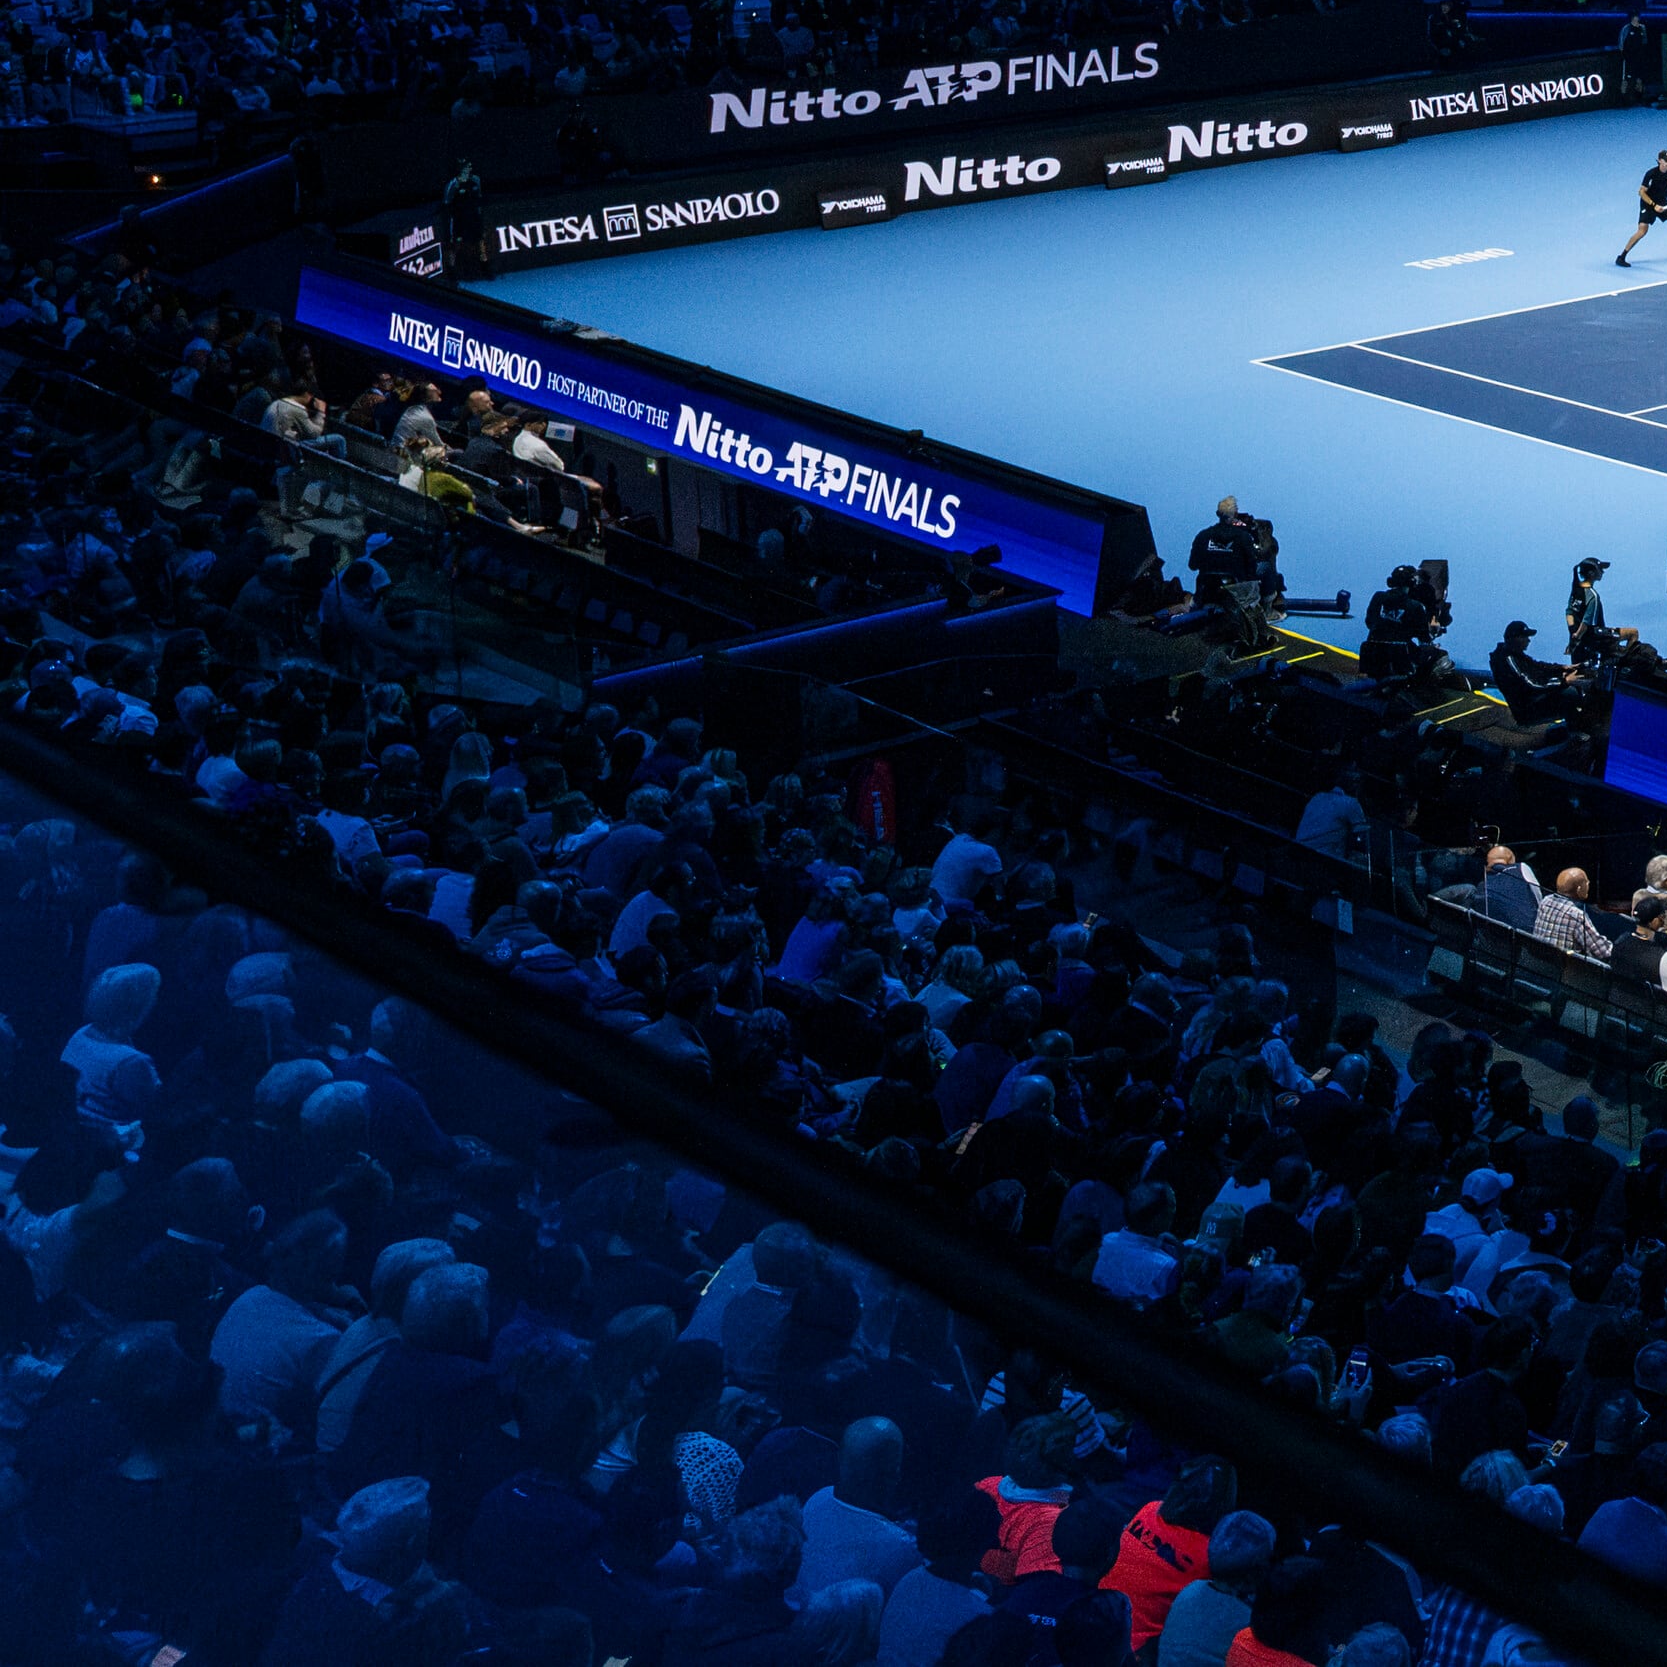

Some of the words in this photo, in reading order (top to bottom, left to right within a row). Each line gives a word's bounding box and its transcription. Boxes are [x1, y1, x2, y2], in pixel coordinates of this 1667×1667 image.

[708, 87, 881, 133] Nitto
[1006, 42, 1160, 93] FINALS
[1409, 92, 1479, 121] INTESA
[1509, 73, 1604, 106] SANPAOLO
[1167, 120, 1308, 163] Nitto
[904, 155, 1062, 201] Nitto
[398, 224, 435, 252] LAVAZZA
[496, 212, 599, 252] INTESA
[645, 188, 781, 231] SANPAOLO
[1403, 247, 1516, 271] TORINO
[388, 311, 441, 356] INTESA
[463, 336, 542, 391] SANPAOLO
[547, 371, 576, 398] HOST
[577, 380, 629, 417] PARTNER
[629, 397, 647, 420] OF
[646, 404, 669, 430] THE
[672, 404, 774, 474] Nitto
[846, 465, 963, 539] FINALS
